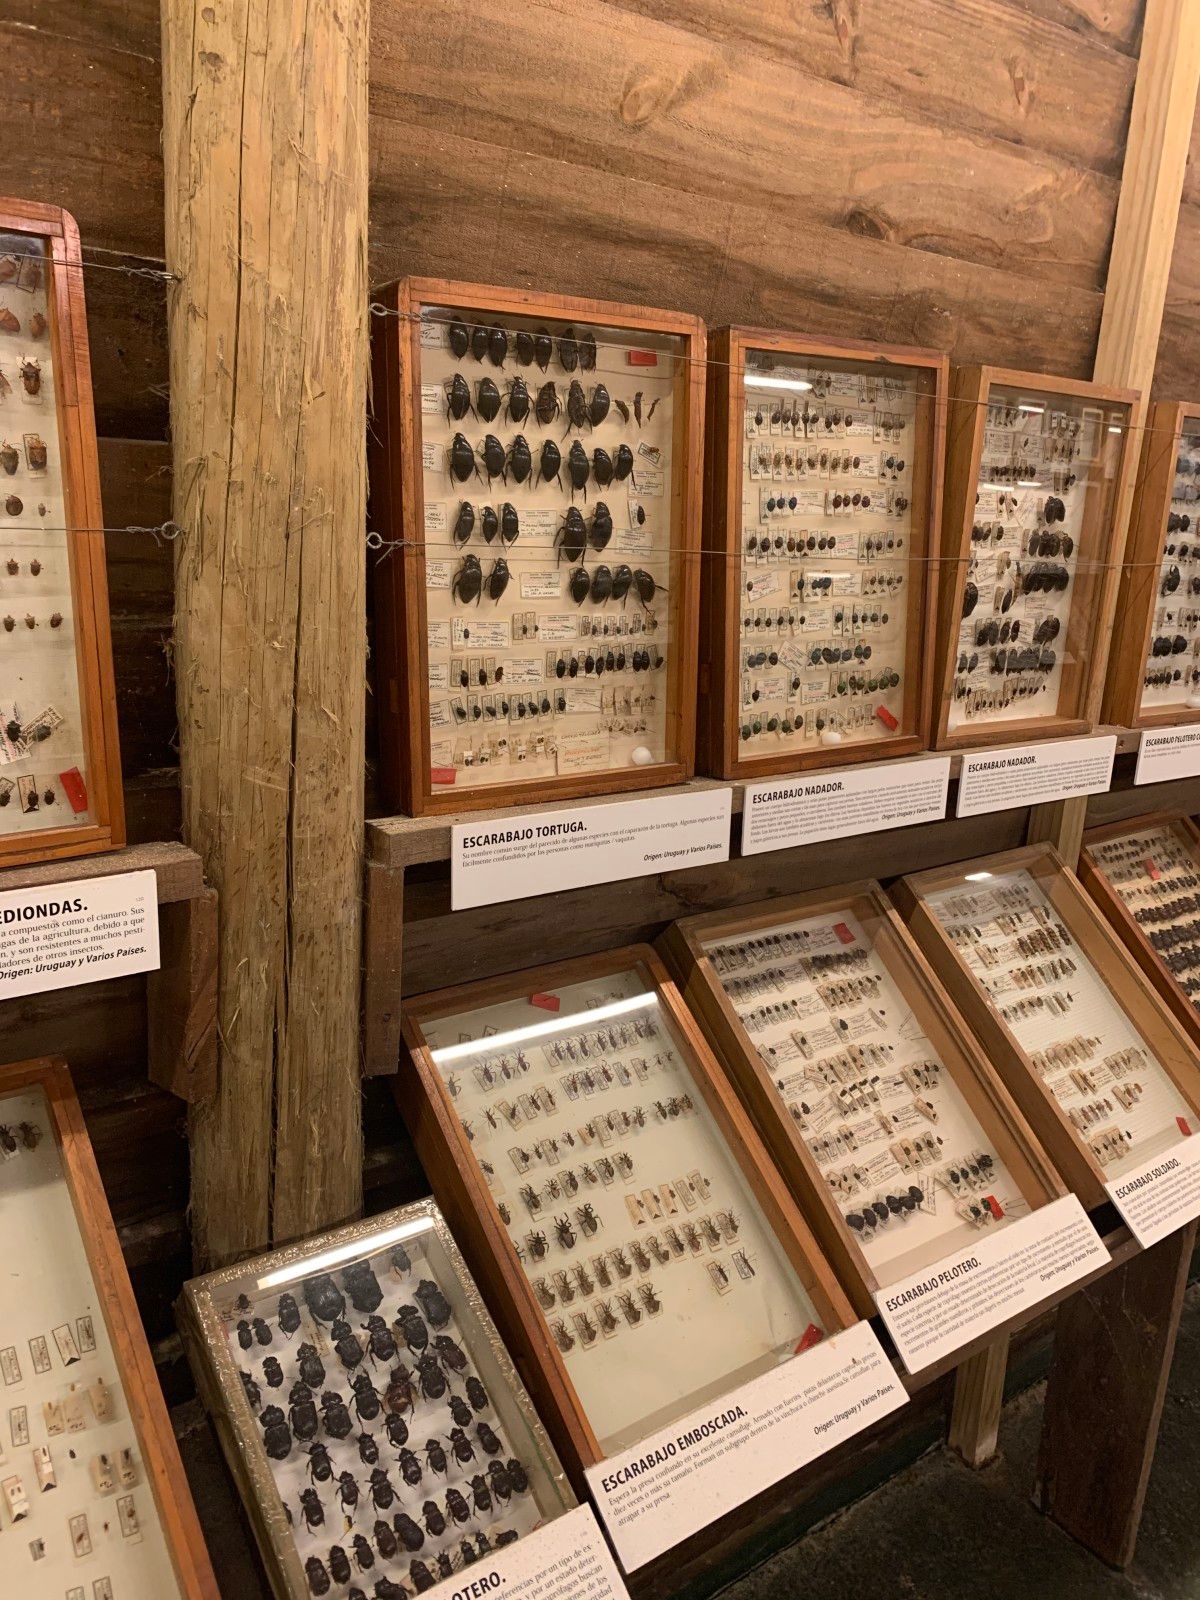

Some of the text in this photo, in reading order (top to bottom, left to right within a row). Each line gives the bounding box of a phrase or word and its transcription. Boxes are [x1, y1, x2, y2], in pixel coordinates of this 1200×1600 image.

[968, 755, 1036, 772] ESCARABAJO NADADOR.
[752, 781, 844, 803] ESCARABAJO NADADOR.
[463, 821, 587, 848] ESCARABAJO TORTUGA.
[470, 849, 493, 858] nombre
[643, 853, 663, 861] Origen:
[663, 849, 686, 857] Uruguay
[690, 845, 706, 853] Varios
[0, 898, 87, 923] DIONDAS.
[8, 920, 60, 935] compuestos
[61, 918, 85, 926] como
[86, 914, 95, 922] el
[96, 910, 128, 920] cianuro.
[130, 907, 145, 915] Sus
[10, 950, 16, 958] y
[18, 946, 34, 954] son
[36, 939, 82, 951] resistentes
[90, 931, 122, 941] muchos
[123, 927, 143, 938] pesti-
[18, 936, 30, 944] de
[32, 934, 40, 942] la
[42, 927, 91, 941] agricultura,
[93, 920, 121, 931] debido
[130, 917, 145, 926] que
[32, 954, 44, 962] de
[45, 951, 68, 960] otros
[69, 945, 104, 955] insectos.
[35, 959, 77, 972] Uruguay
[77, 957, 85, 967] y
[86, 952, 115, 963] Varios
[116, 946, 147, 957] Países.
[1115, 1158, 1181, 1199] ESCARABAJO SOLDADO.
[886, 1257, 981, 1311] ESCARABAJO PELOTERO.
[813, 1419, 835, 1435] Origen:
[833, 1406, 858, 1422] Uruguay
[856, 1403, 862, 1411] y
[860, 1393, 878, 1406] Varios
[602, 1406, 748, 1492] ESCARABAJO EMBOSCADA.
[613, 1505, 627, 1516] diez
[626, 1495, 645, 1507] veces
[649, 1484, 663, 1495] más
[693, 1454, 716, 1469] Forman
[724, 1434, 750, 1452] subgrupo
[749, 1424, 768, 1437] dentro
[767, 1419, 774, 1427] de
[637, 1476, 655, 1491] presa
[655, 1460, 684, 1479] confiando
[683, 1455, 693, 1463] en
[700, 1436, 725, 1454] excelente
[618, 1509, 640, 1526] atrapar
[645, 1502, 654, 1510] su
[653, 1492, 671, 1507] presa
[535, 1570, 548, 1584] por
[548, 1564, 559, 1573] un
[573, 1549, 582, 1559] de
[577, 1564, 603, 1583] buscan
[531, 1586, 544, 1600] por
[545, 1579, 555, 1589] un
[555, 1565, 578, 1583] estado
[587, 1582, 597, 1592] de
[596, 1576, 608, 1586] los
